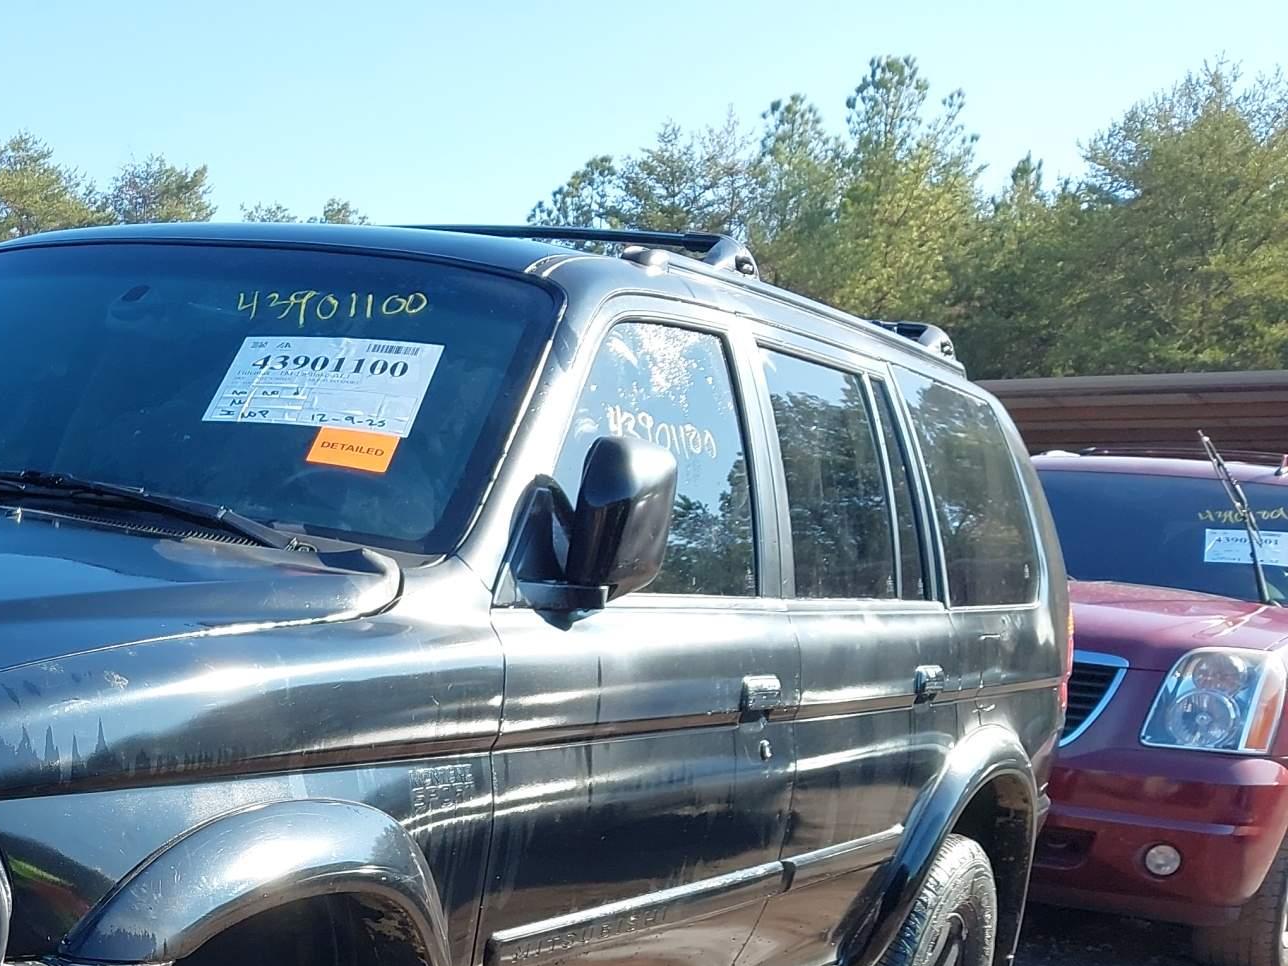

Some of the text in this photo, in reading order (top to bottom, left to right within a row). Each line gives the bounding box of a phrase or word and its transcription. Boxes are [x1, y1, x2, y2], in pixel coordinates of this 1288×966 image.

[237, 290, 428, 328] 43901100
[252, 354, 409, 378] 43901100
[320, 440, 385, 458] DETAILED
[511, 905, 667, 966] MITSUBISHI
